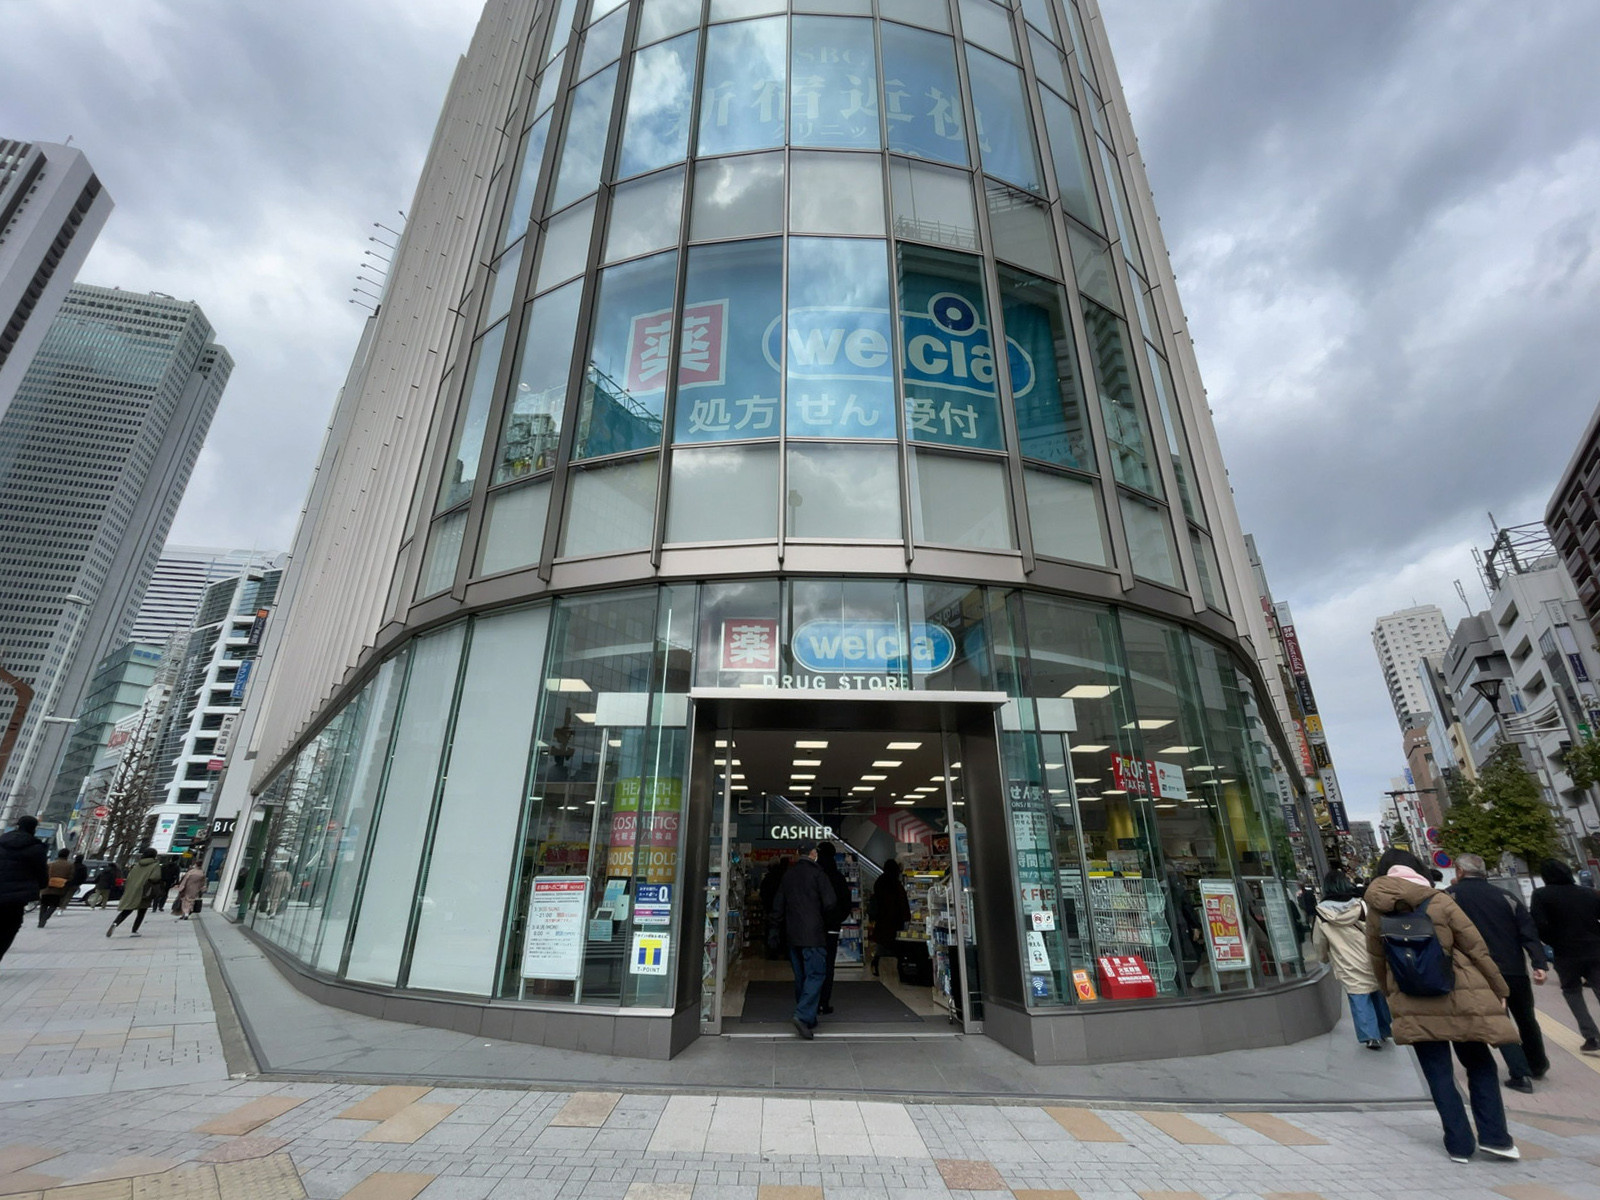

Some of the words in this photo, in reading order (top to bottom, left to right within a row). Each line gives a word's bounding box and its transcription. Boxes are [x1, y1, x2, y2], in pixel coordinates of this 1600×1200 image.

[689, 393, 979, 440] 処方せん受付
[729, 624, 771, 664] 薬
[762, 674, 826, 690] DRUG
[613, 816, 678, 831] COSMETICS
[770, 825, 834, 840] CASHIER
